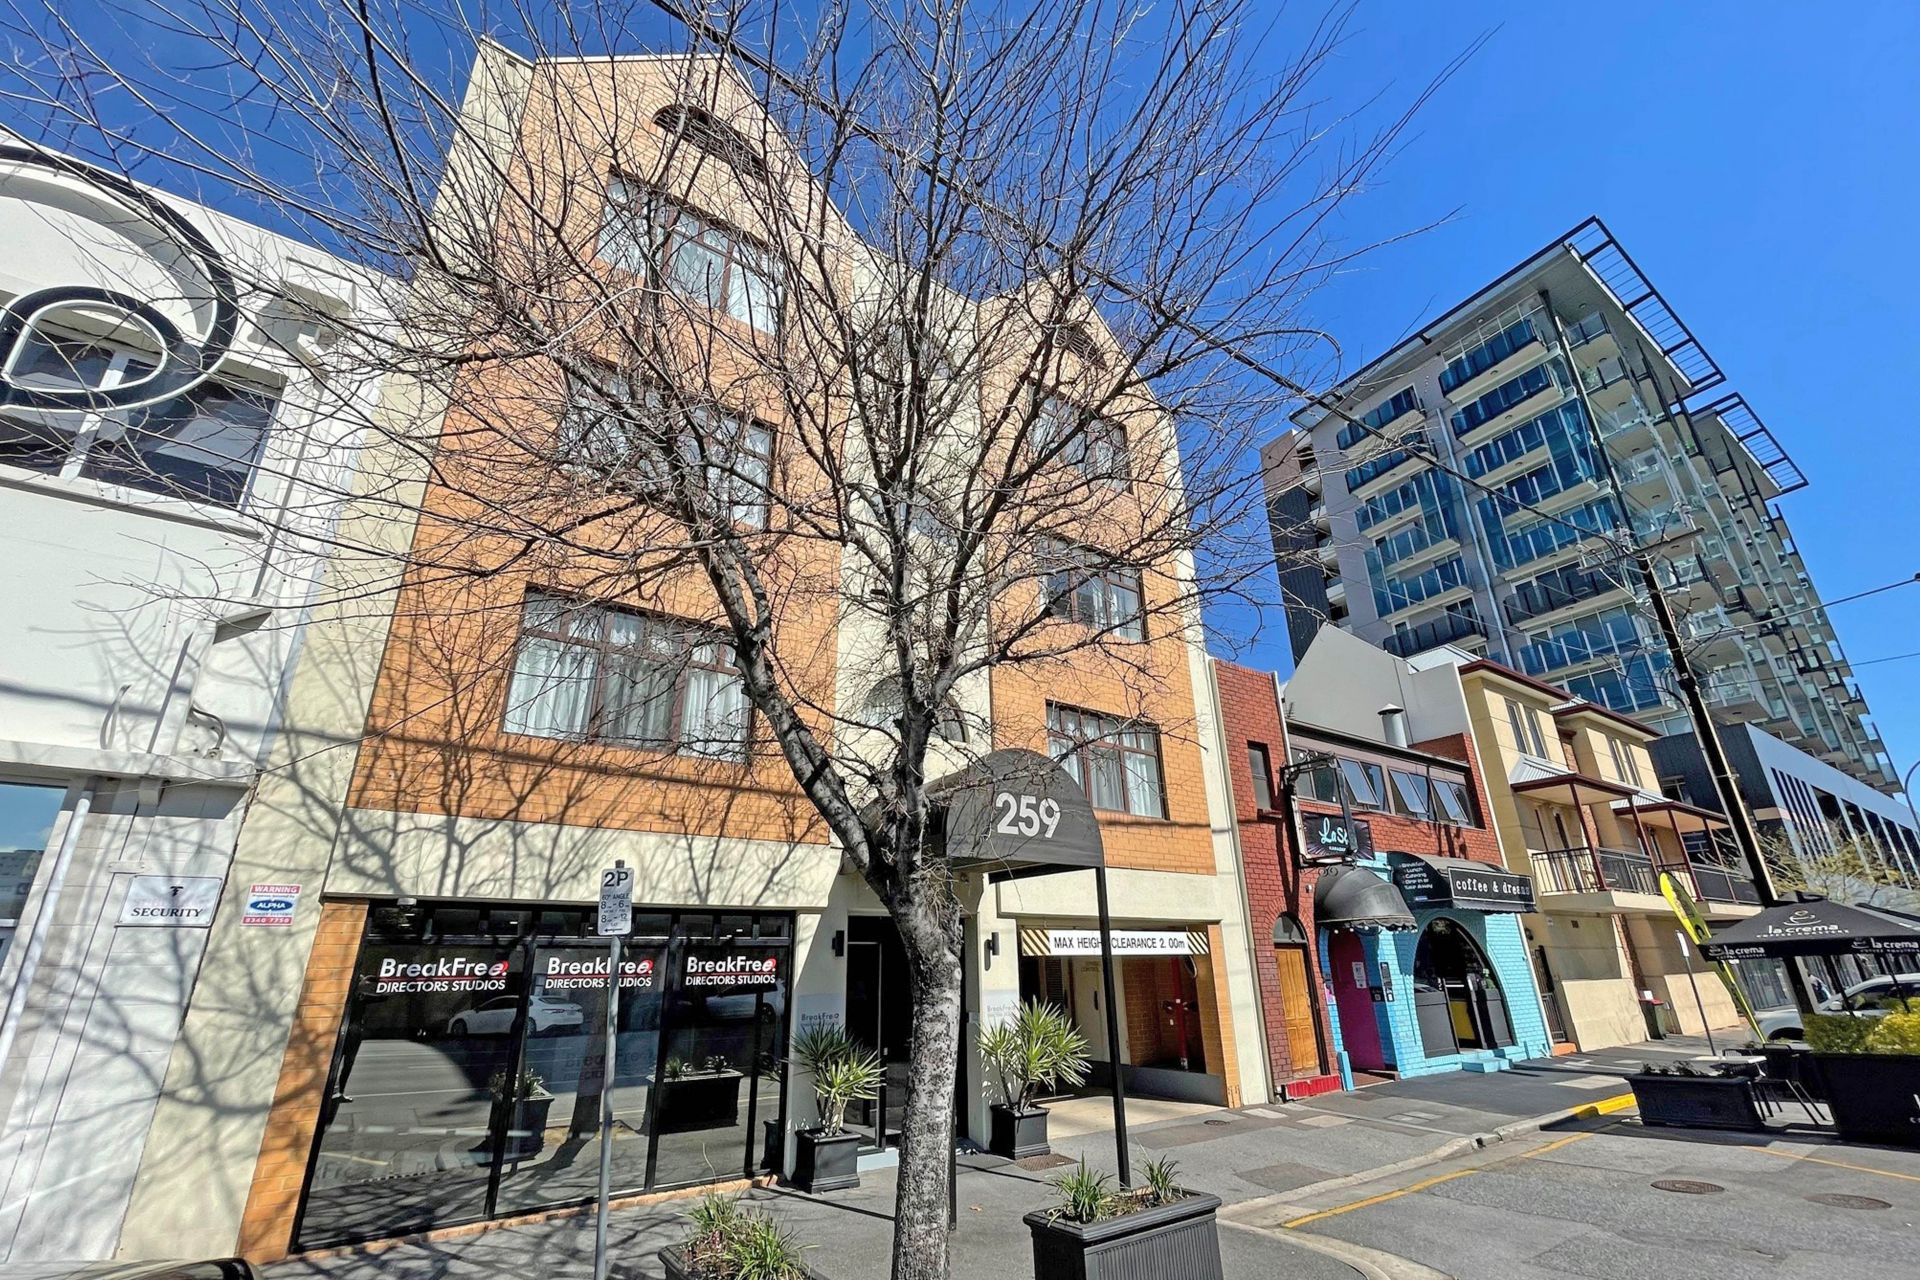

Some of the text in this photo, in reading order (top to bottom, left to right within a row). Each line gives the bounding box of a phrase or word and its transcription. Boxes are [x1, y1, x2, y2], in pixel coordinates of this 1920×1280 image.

[996, 792, 1061, 839] 259
[604, 871, 629, 887] 2P
[1456, 878, 1488, 893] coffee
[1493, 881, 1499, 893] &
[131, 907, 203, 918] SECURITY
[1785, 924, 1839, 934] crema
[1054, 937, 1074, 949] MAX
[1077, 937, 1102, 949] HEIGH
[1111, 937, 1157, 949] CLEARANCE
[1883, 941, 1919, 949] crema
[1735, 947, 1765, 955] crema
[376, 979, 506, 993] DIRECTORS STUDIOS
[545, 978, 604, 989] DIRECTORS
[685, 974, 776, 986] DIRECTORS STUDIOS
